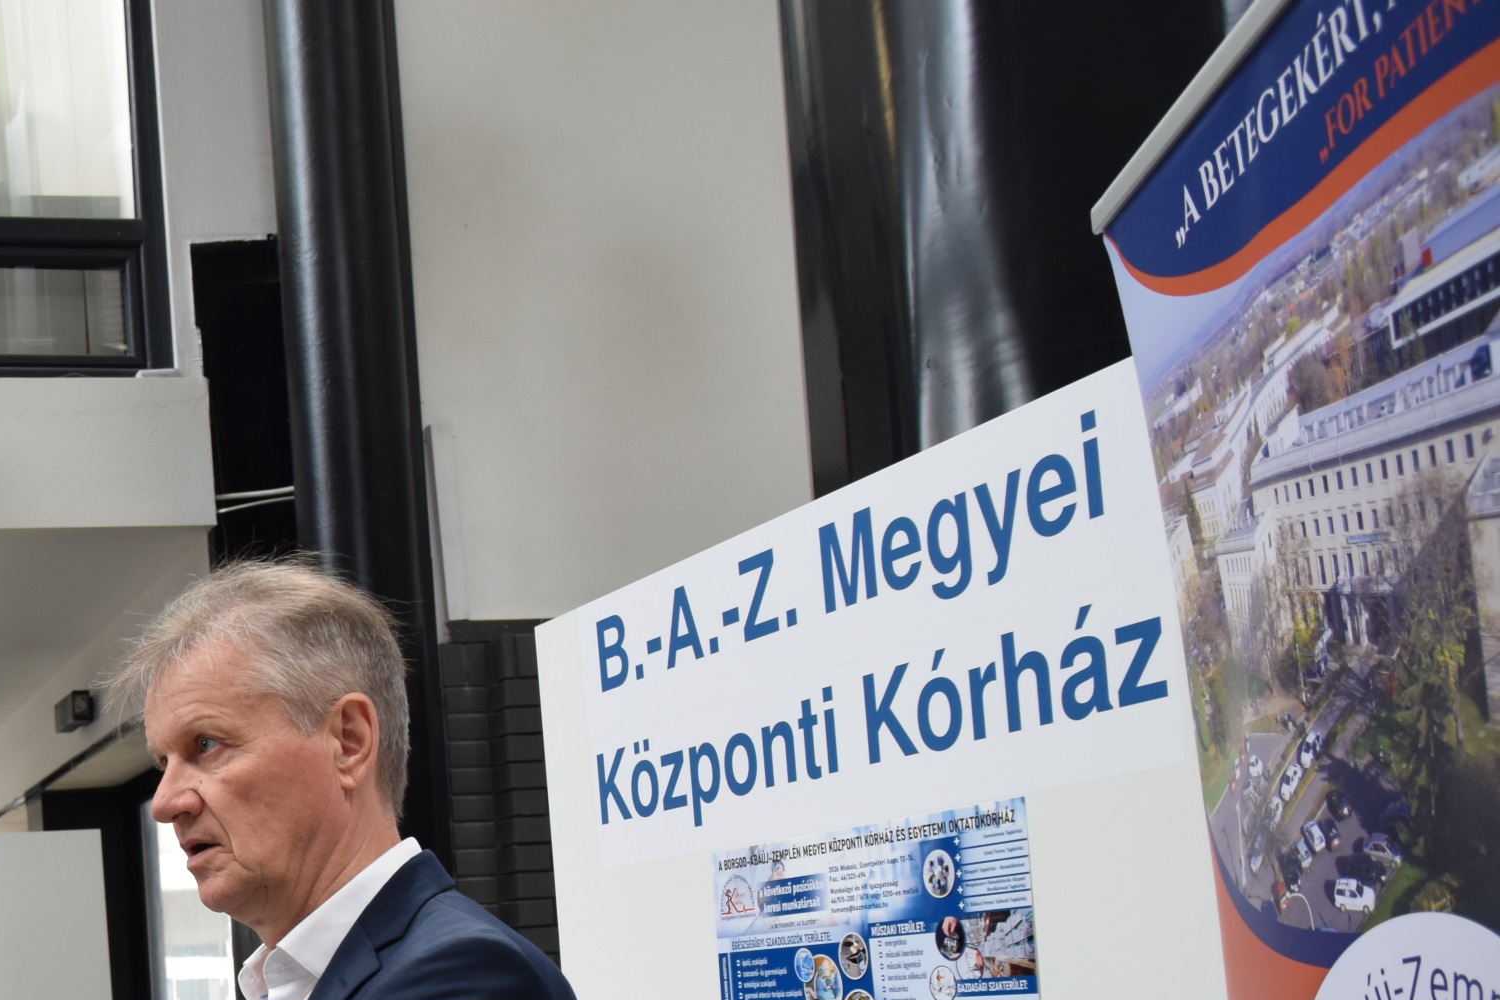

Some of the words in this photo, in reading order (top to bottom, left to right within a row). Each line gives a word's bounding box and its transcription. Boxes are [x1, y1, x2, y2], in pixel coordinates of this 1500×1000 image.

[1374, 0, 1482, 99] PATIEN
[596, 548, 798, 692] B.-A.-Z.
[819, 410, 1104, 614] Megyei
[596, 686, 839, 826] Központi
[862, 604, 1169, 765] Kórház
[718, 861, 724, 872] A
[724, 848, 800, 870] BORSOD-ABAÚJ-ZEMPLÉN
[802, 843, 827, 858] MEGYEI
[828, 836, 862, 852] KÖZPONTI
[864, 830, 894, 846] KÓRHÁZ
[897, 826, 906, 841] ÉS
[908, 822, 946, 840] EGYETEMI
[949, 807, 1016, 832] OKTATÓKÓRHÁZ
[760, 890, 762, 898] a
[764, 882, 792, 896] következő
[764, 900, 780, 913] keresi
[782, 896, 821, 911] munkatársait
[871, 923, 897, 936] MŰSZAKI
[898, 920, 926, 934] TERÜLET:
[766, 932, 803, 947] SZAKDOLGOZÓK
[804, 930, 831, 943] TERÜLETE:
[957, 980, 987, 993] GAZDASÁGI
[989, 978, 1028, 991] SZAKTERÜLET:
